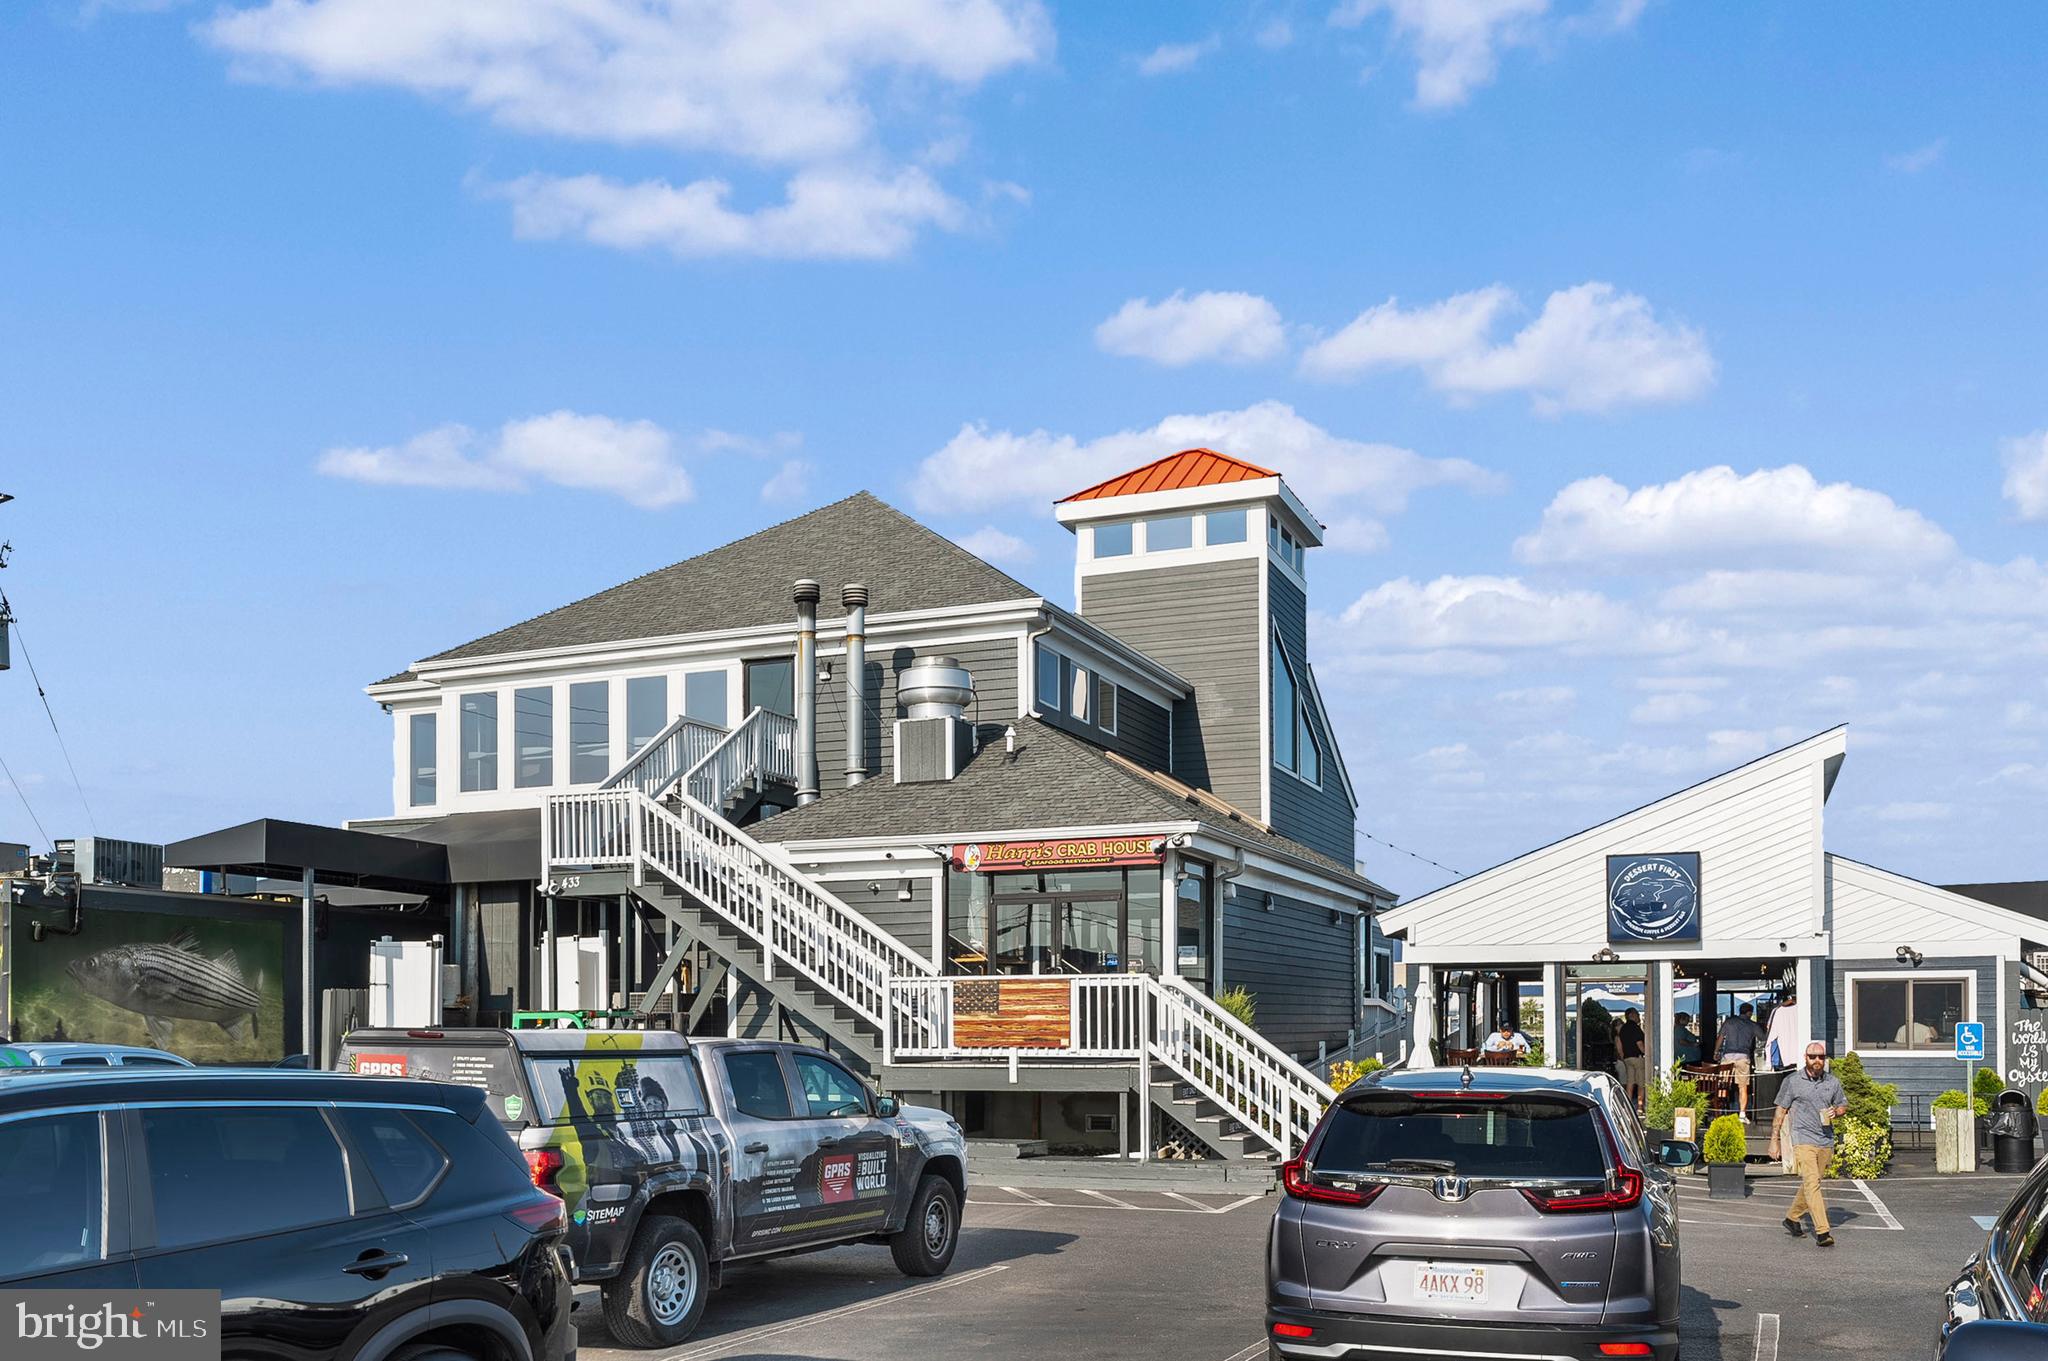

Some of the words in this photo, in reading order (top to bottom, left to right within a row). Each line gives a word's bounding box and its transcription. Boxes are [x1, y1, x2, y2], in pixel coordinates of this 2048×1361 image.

[984, 843, 1053, 861] Harris
[1057, 843, 1096, 857] CRAB
[1624, 863, 1657, 882] DESSERT
[1658, 864, 1681, 879] FIRST
[561, 876, 580, 889] 433
[2013, 1018, 2042, 1033] The
[359, 1062, 403, 1076] GPRS
[2019, 1057, 2039, 1071] My
[2008, 1069, 2048, 1088] Oyste
[857, 1150, 887, 1161] VISUALIZING
[824, 1162, 851, 1179] GPRS
[861, 1159, 887, 1175] BUILT
[856, 1174, 887, 1190] WORLD
[1316, 1240, 1358, 1249] CR-V
[1561, 1251, 1598, 1260] AWD
[1419, 1274, 1459, 1293] 4AKX
[1464, 1276, 1484, 1294] 98
